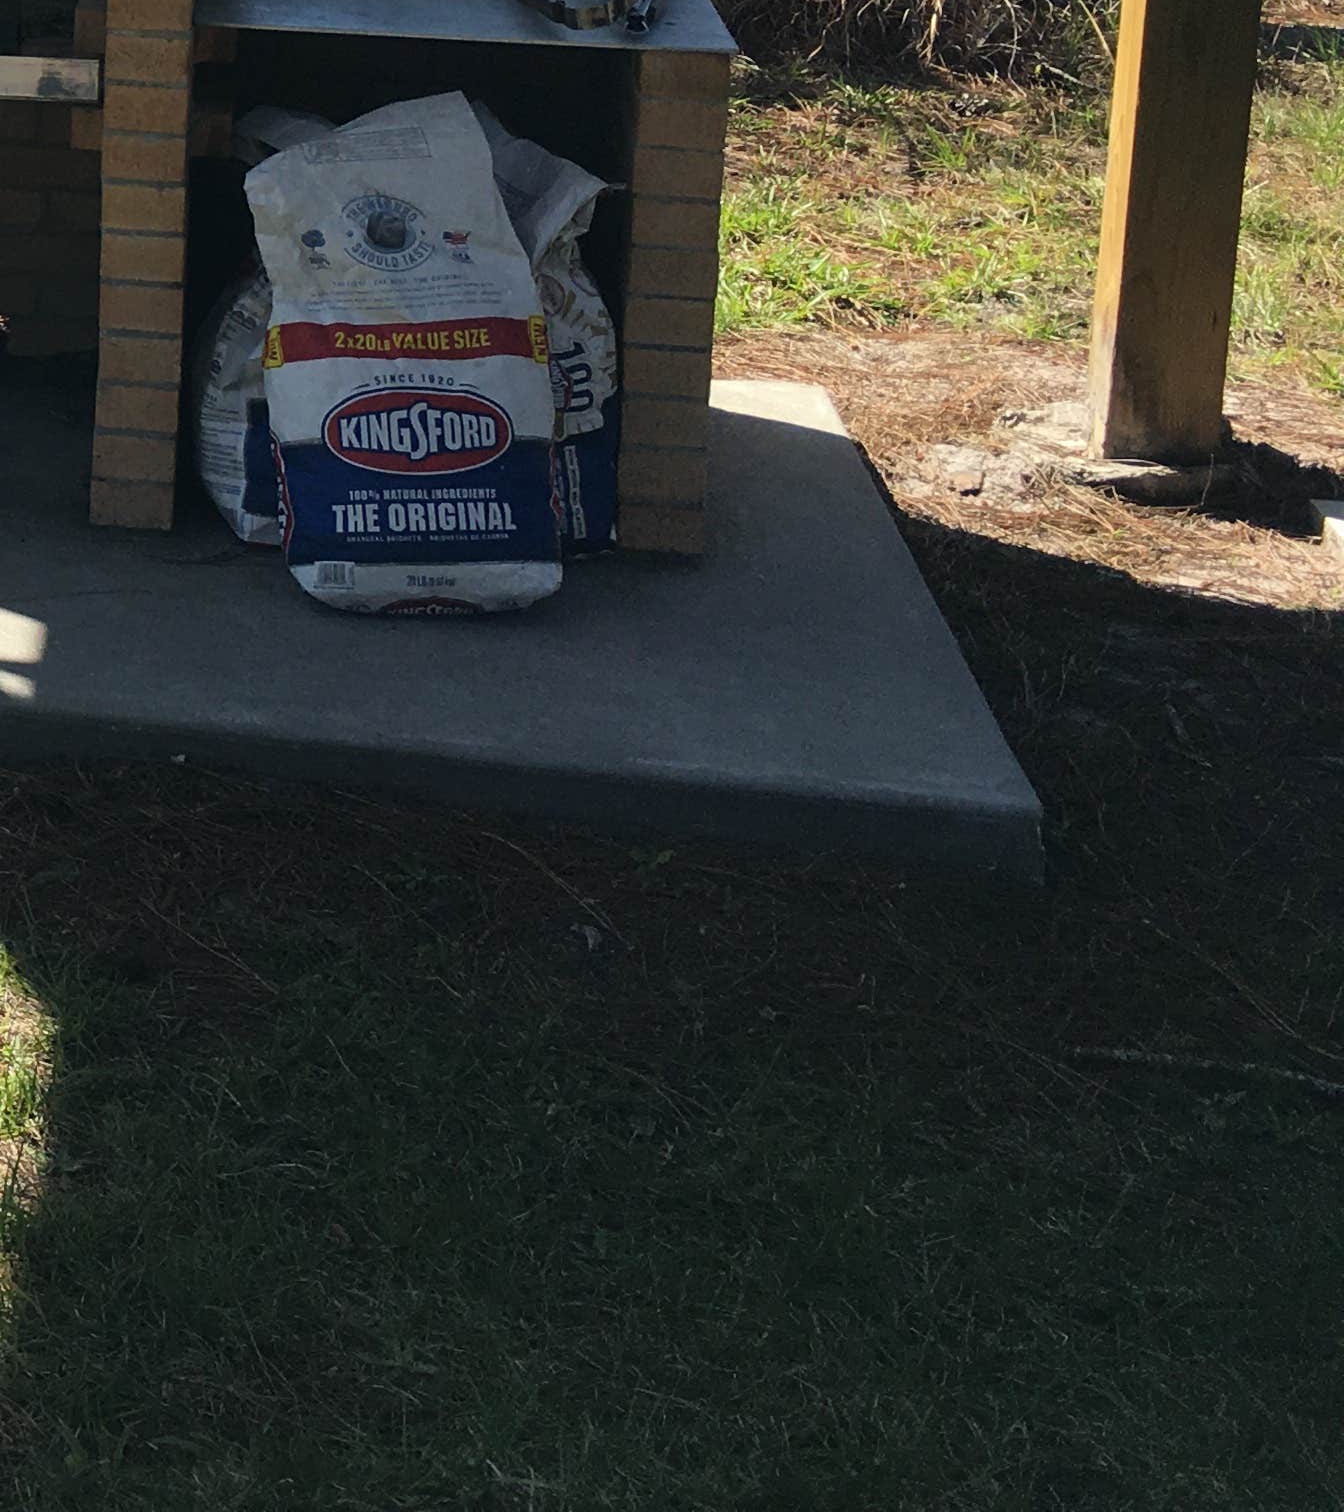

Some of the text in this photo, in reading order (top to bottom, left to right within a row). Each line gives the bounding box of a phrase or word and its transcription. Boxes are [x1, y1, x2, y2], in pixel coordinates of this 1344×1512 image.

[351, 242, 399, 268] SHOULD
[392, 330, 452, 351] VALUE
[453, 328, 492, 349] SIZE
[374, 373, 455, 387] SINCE 1920
[339, 402, 498, 461] KINGSFORD
[383, 488, 429, 500] NATURAL
[431, 488, 497, 500] INGREDIENTS
[332, 501, 517, 534] THE ORIGINAL
